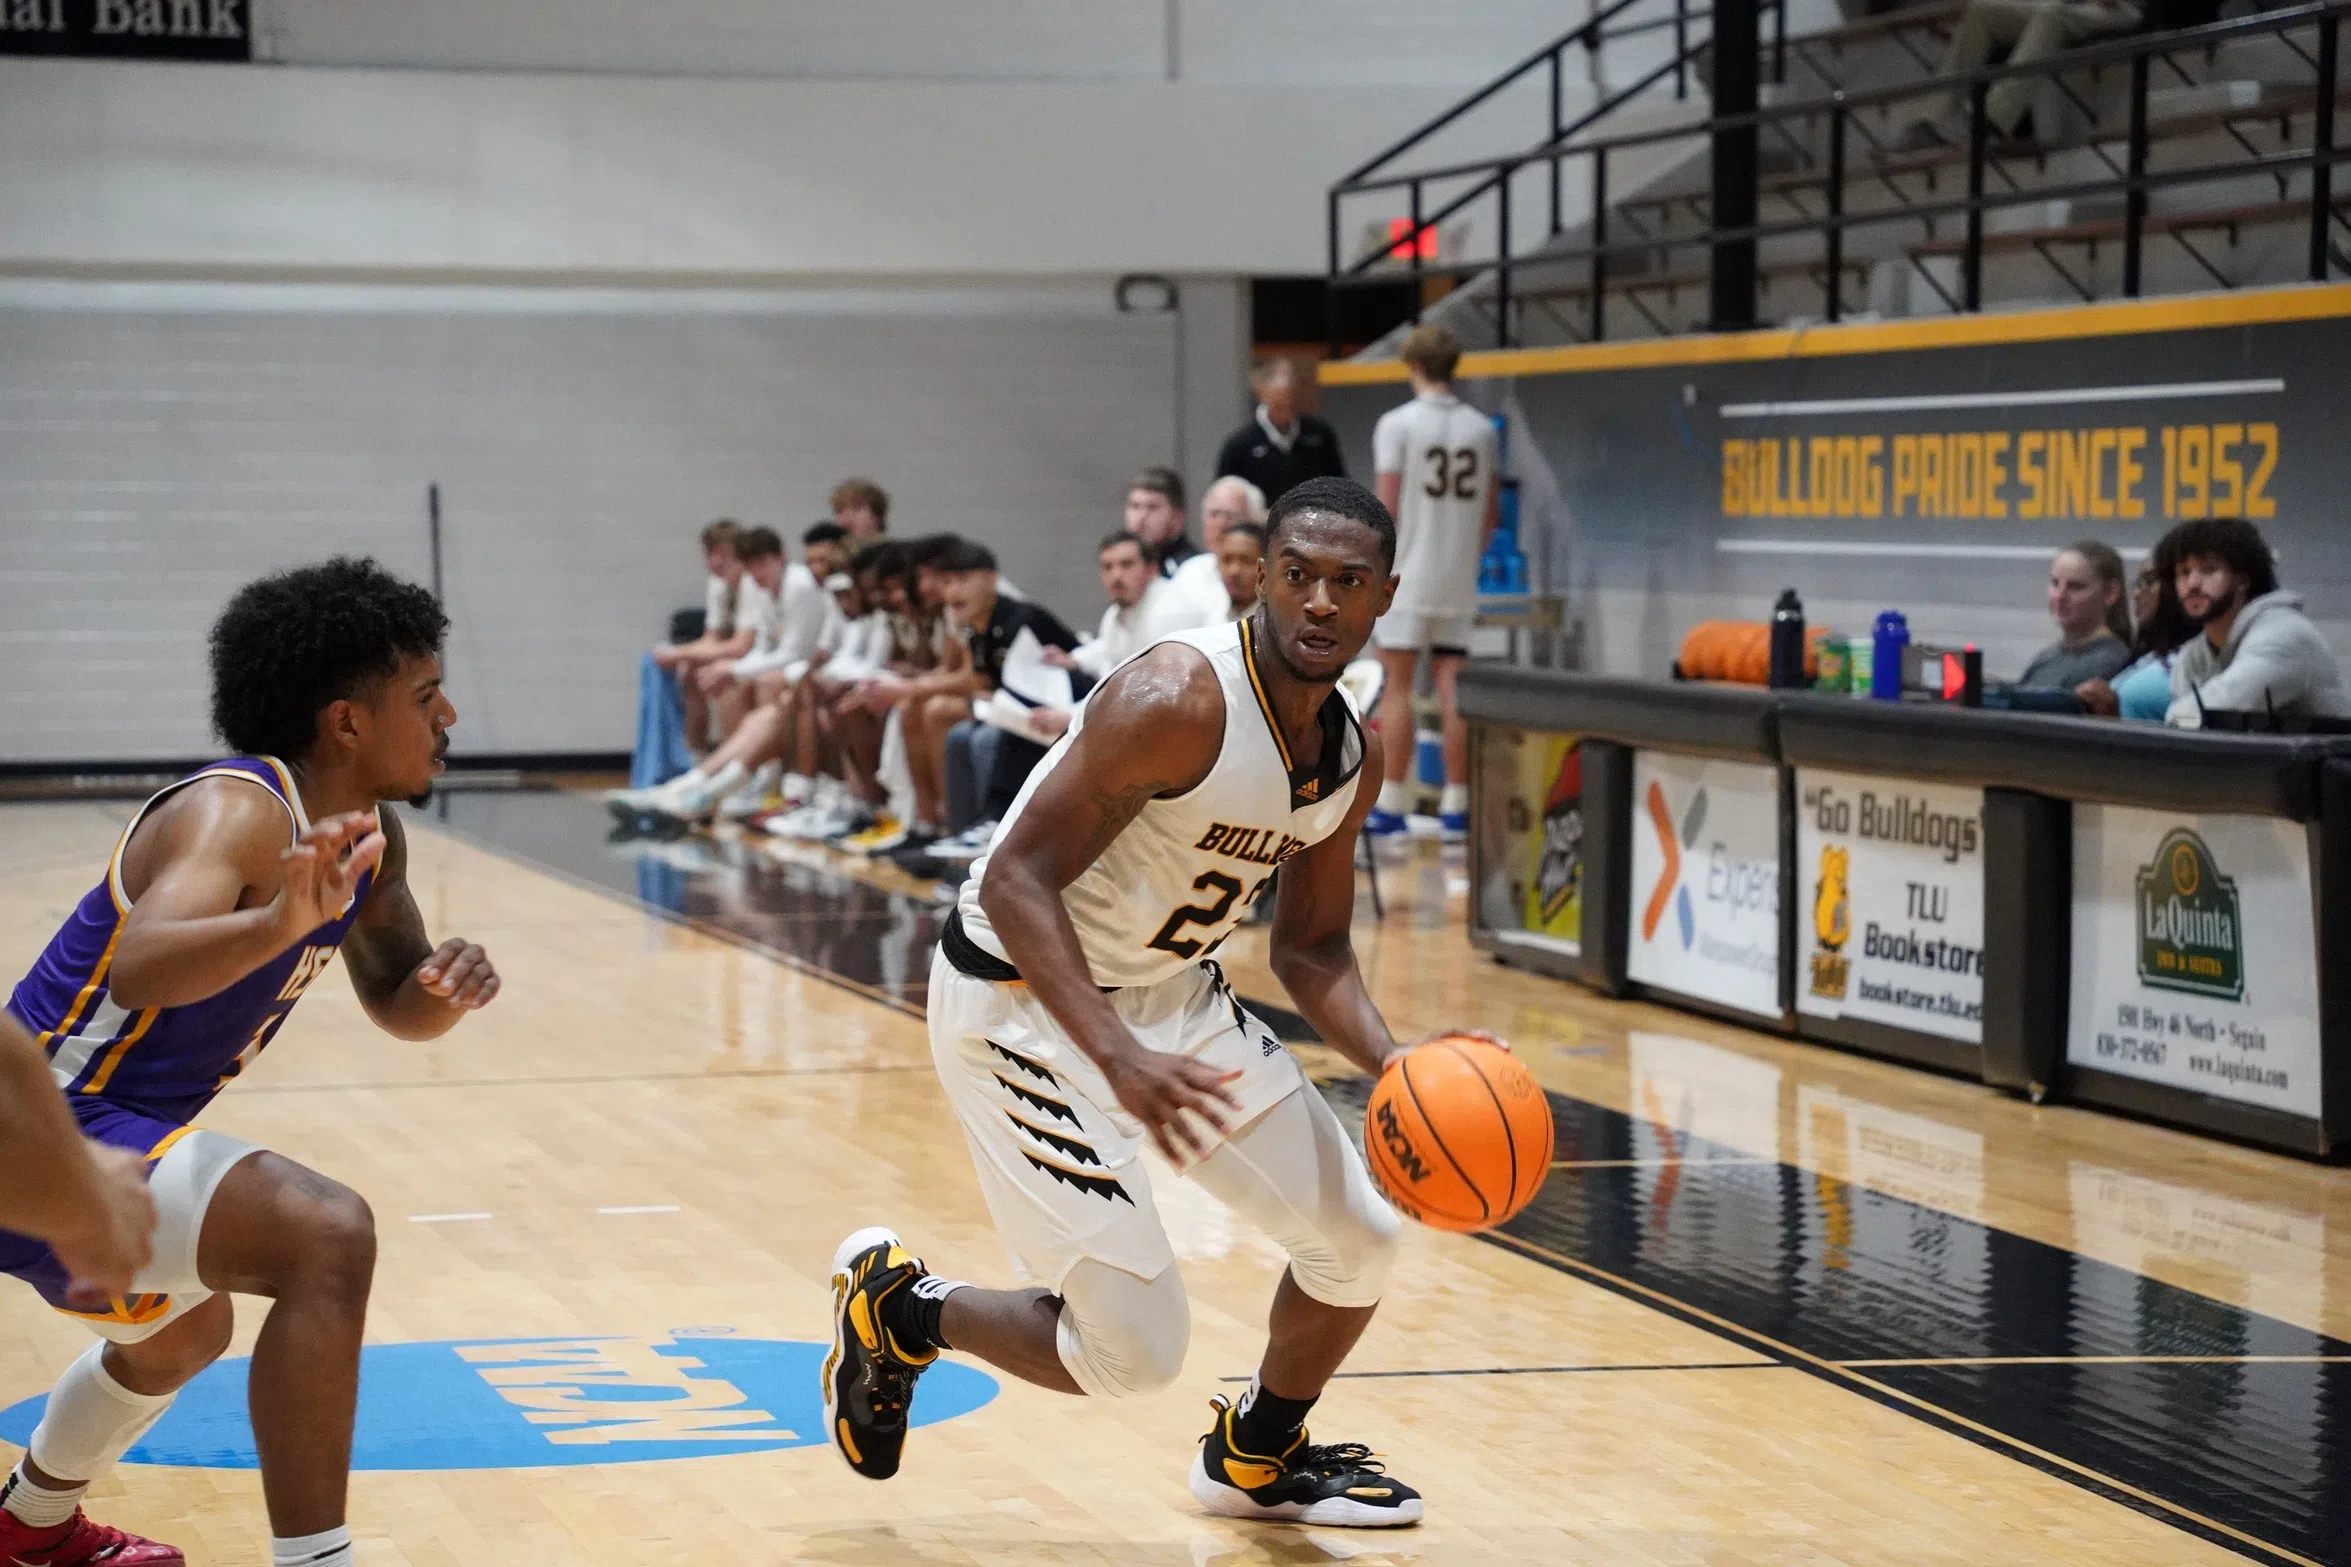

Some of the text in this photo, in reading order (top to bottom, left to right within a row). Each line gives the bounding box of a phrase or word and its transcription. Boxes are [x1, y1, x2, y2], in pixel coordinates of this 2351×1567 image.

[92, 0, 244, 38] Bank
[1425, 446, 1477, 499] 32
[1721, 423, 2279, 518] BULLDOG PRIDE SINCE 1952
[1145, 870, 1273, 961] 2
[1906, 880, 1949, 924] TLU
[2144, 890, 2234, 952] LaQuinta
[1376, 1097, 1433, 1185] NCAA
[451, 1336, 802, 1445] NCAA
